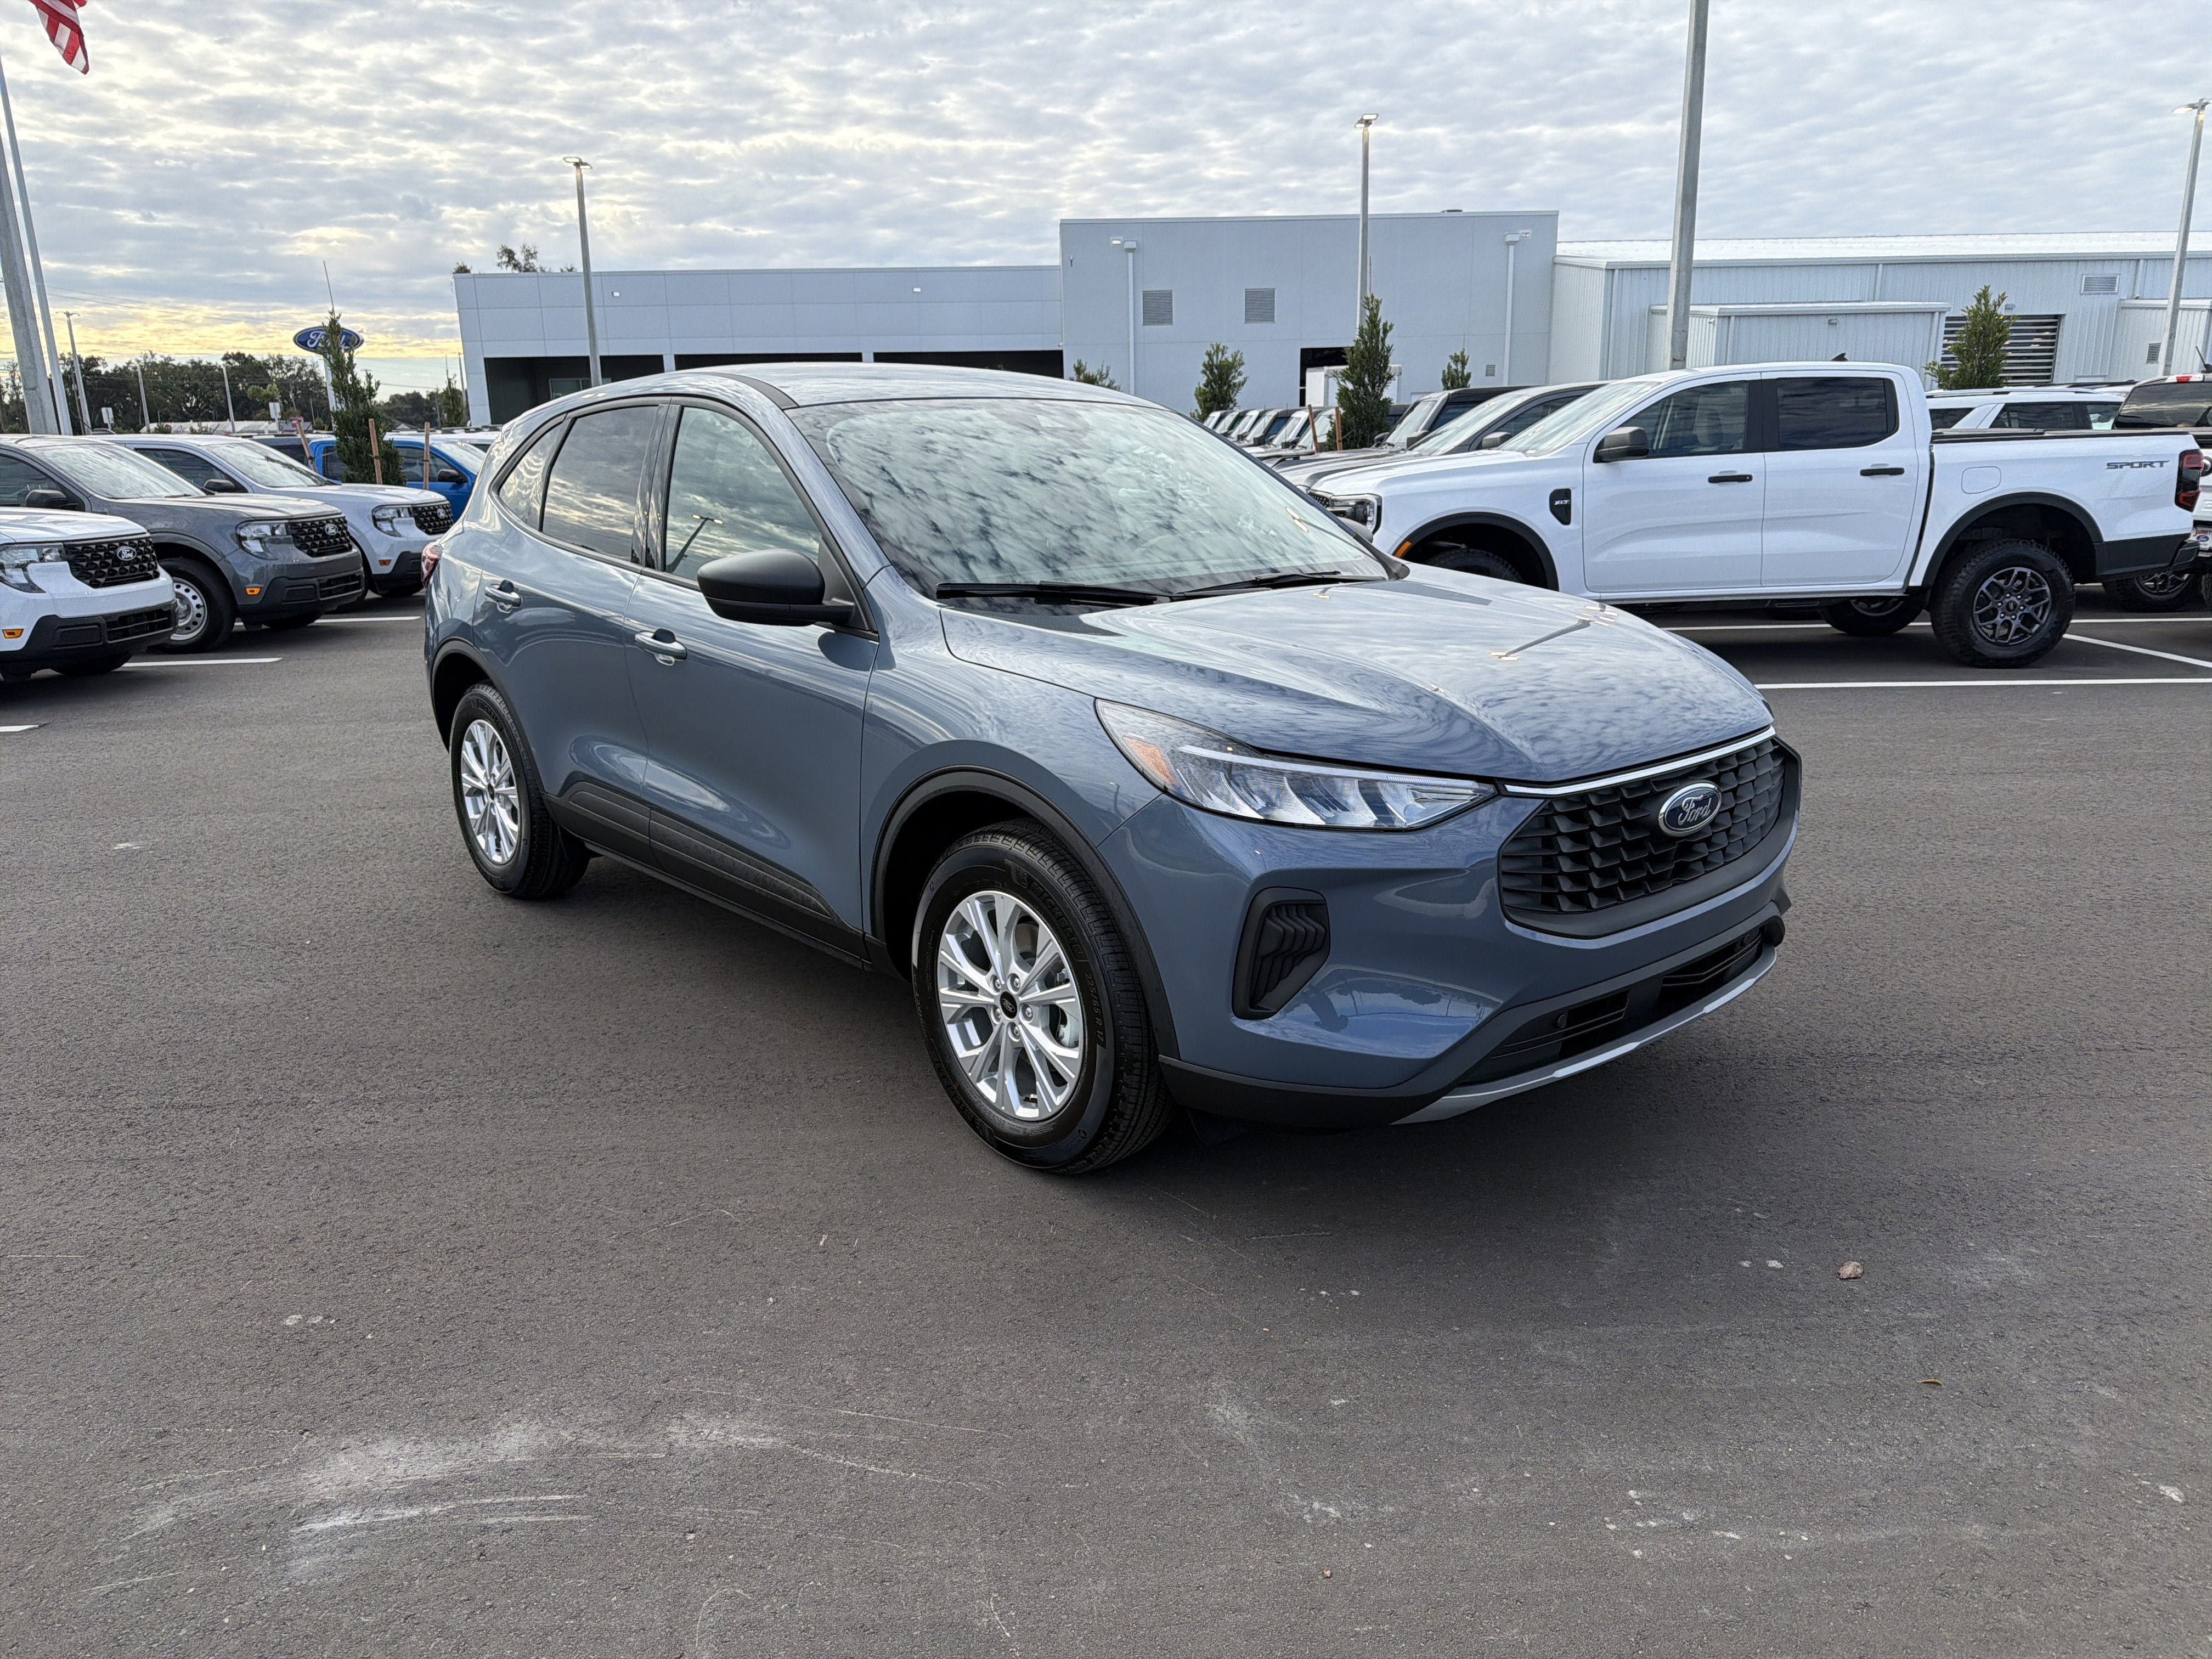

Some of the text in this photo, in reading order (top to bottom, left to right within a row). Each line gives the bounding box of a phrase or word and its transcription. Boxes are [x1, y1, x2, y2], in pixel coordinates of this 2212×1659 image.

[307, 330, 349, 349] Fod
[2106, 460, 2170, 469] SPORT
[2193, 528, 2212, 537] JARRET
[121, 549, 133, 558] Ford
[1678, 794, 1712, 826] Ford
[1029, 881, 1084, 956] MICHELIN
[1003, 1000, 1013, 1011] Ford
[1085, 973, 1104, 1042] 225/65 R 17
